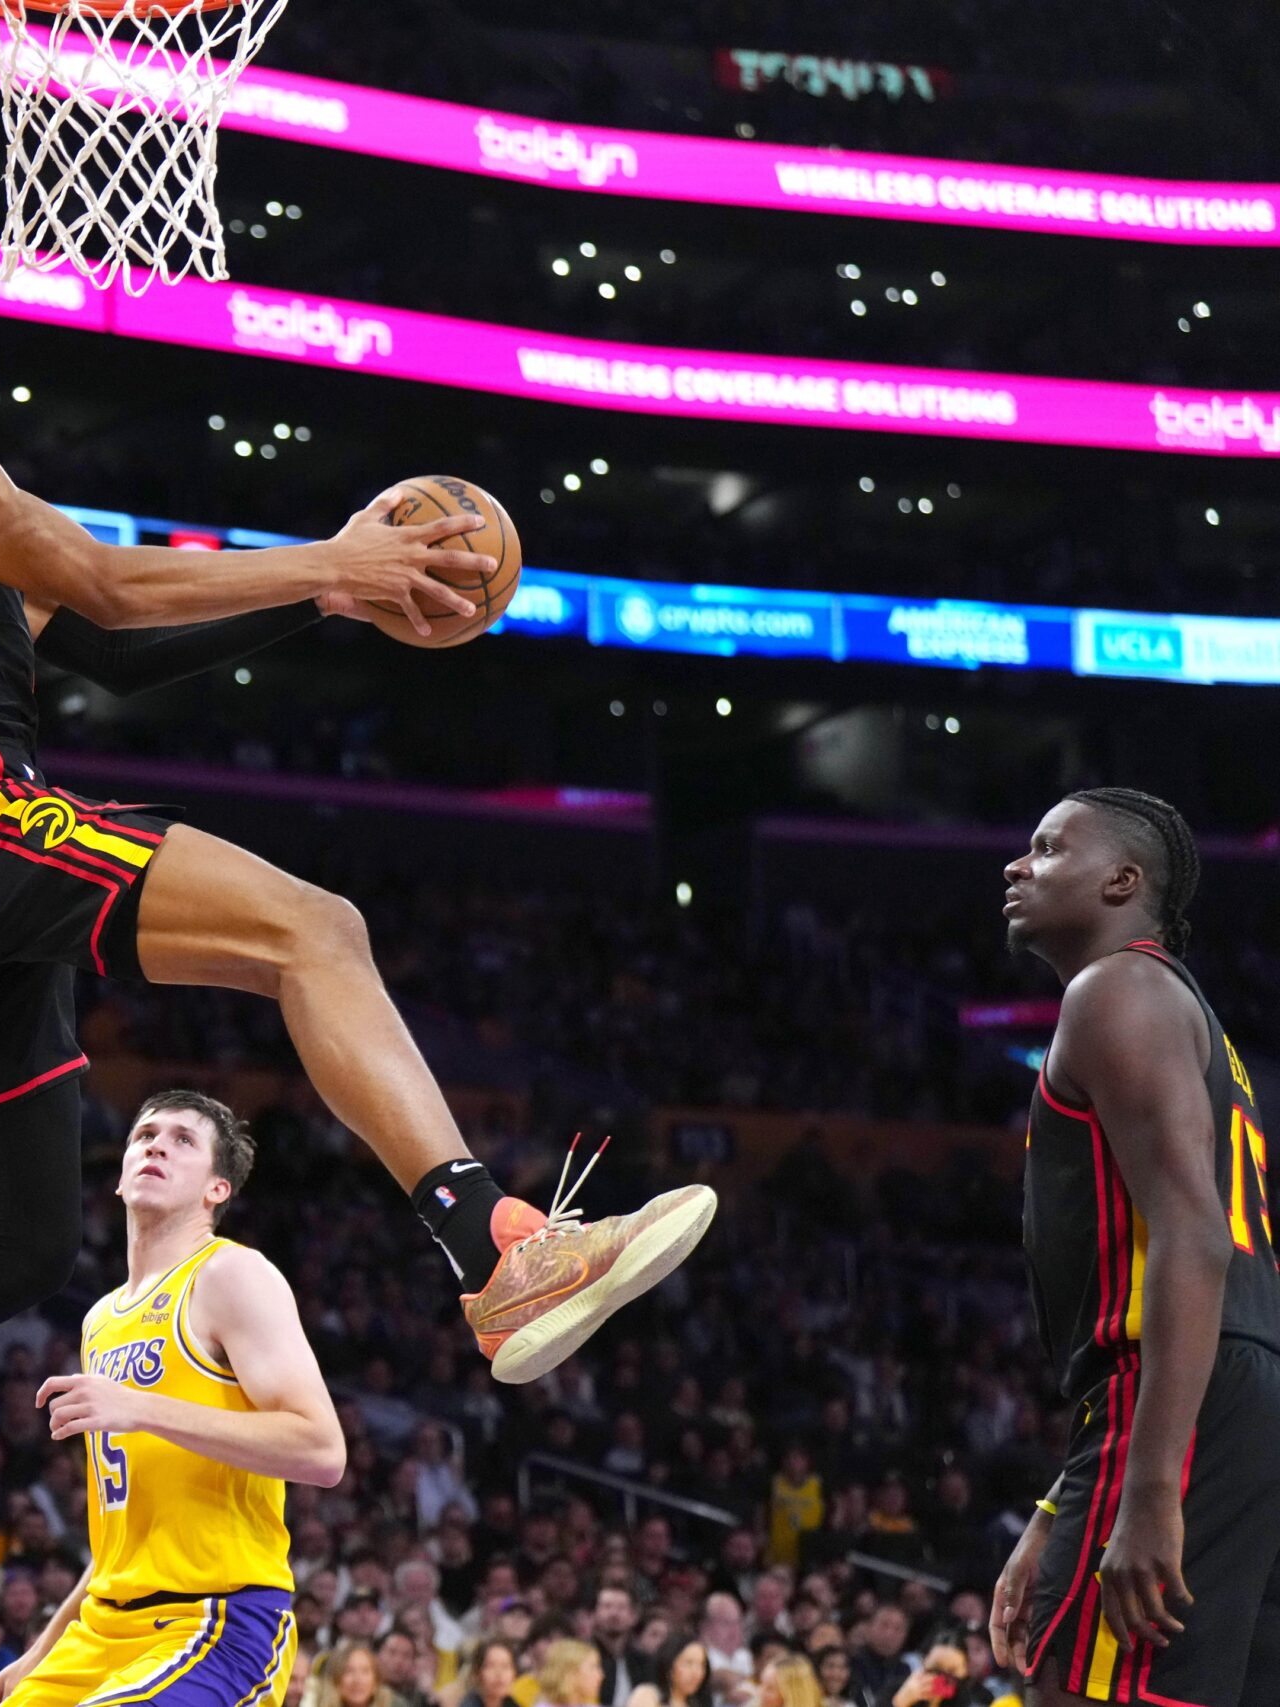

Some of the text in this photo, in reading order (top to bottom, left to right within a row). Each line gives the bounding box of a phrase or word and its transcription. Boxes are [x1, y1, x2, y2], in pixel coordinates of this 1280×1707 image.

[474, 115, 638, 187] boldyn
[775, 161, 1276, 232] WIRELESS COVERAGE SOLUTIONS
[227, 289, 393, 365] boldyn
[517, 346, 1018, 426] WIRELESS COVERAGE SOLUTIONS
[1101, 629, 1174, 664] UCLA
[141, 1311, 171, 1326] bibigo
